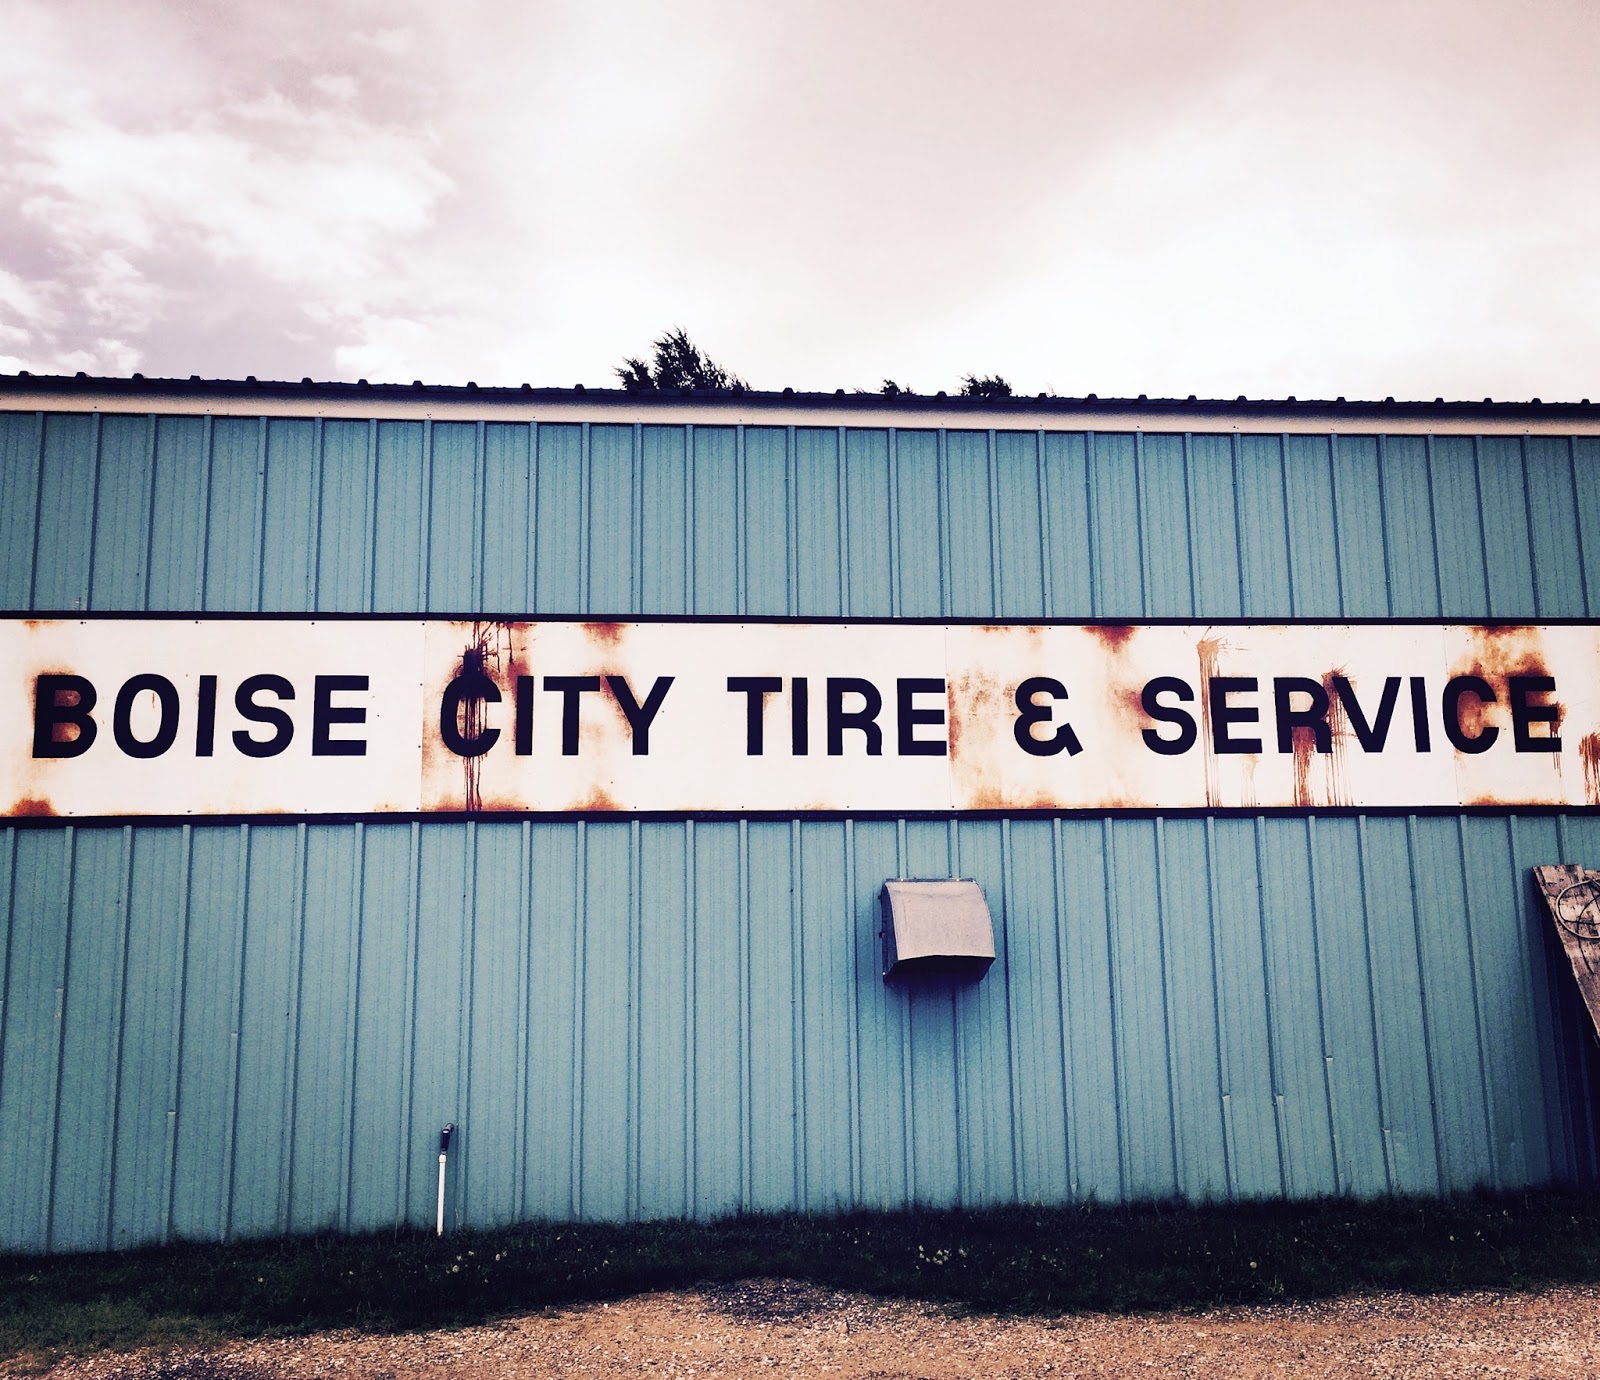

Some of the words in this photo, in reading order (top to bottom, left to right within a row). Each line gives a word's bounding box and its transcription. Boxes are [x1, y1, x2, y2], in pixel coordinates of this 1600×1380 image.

[32, 674, 370, 759] BOISE
[440, 674, 676, 757] CITY
[727, 676, 948, 757] TIRE
[1013, 676, 1084, 757] &
[1141, 675, 1562, 756] SERVICE
